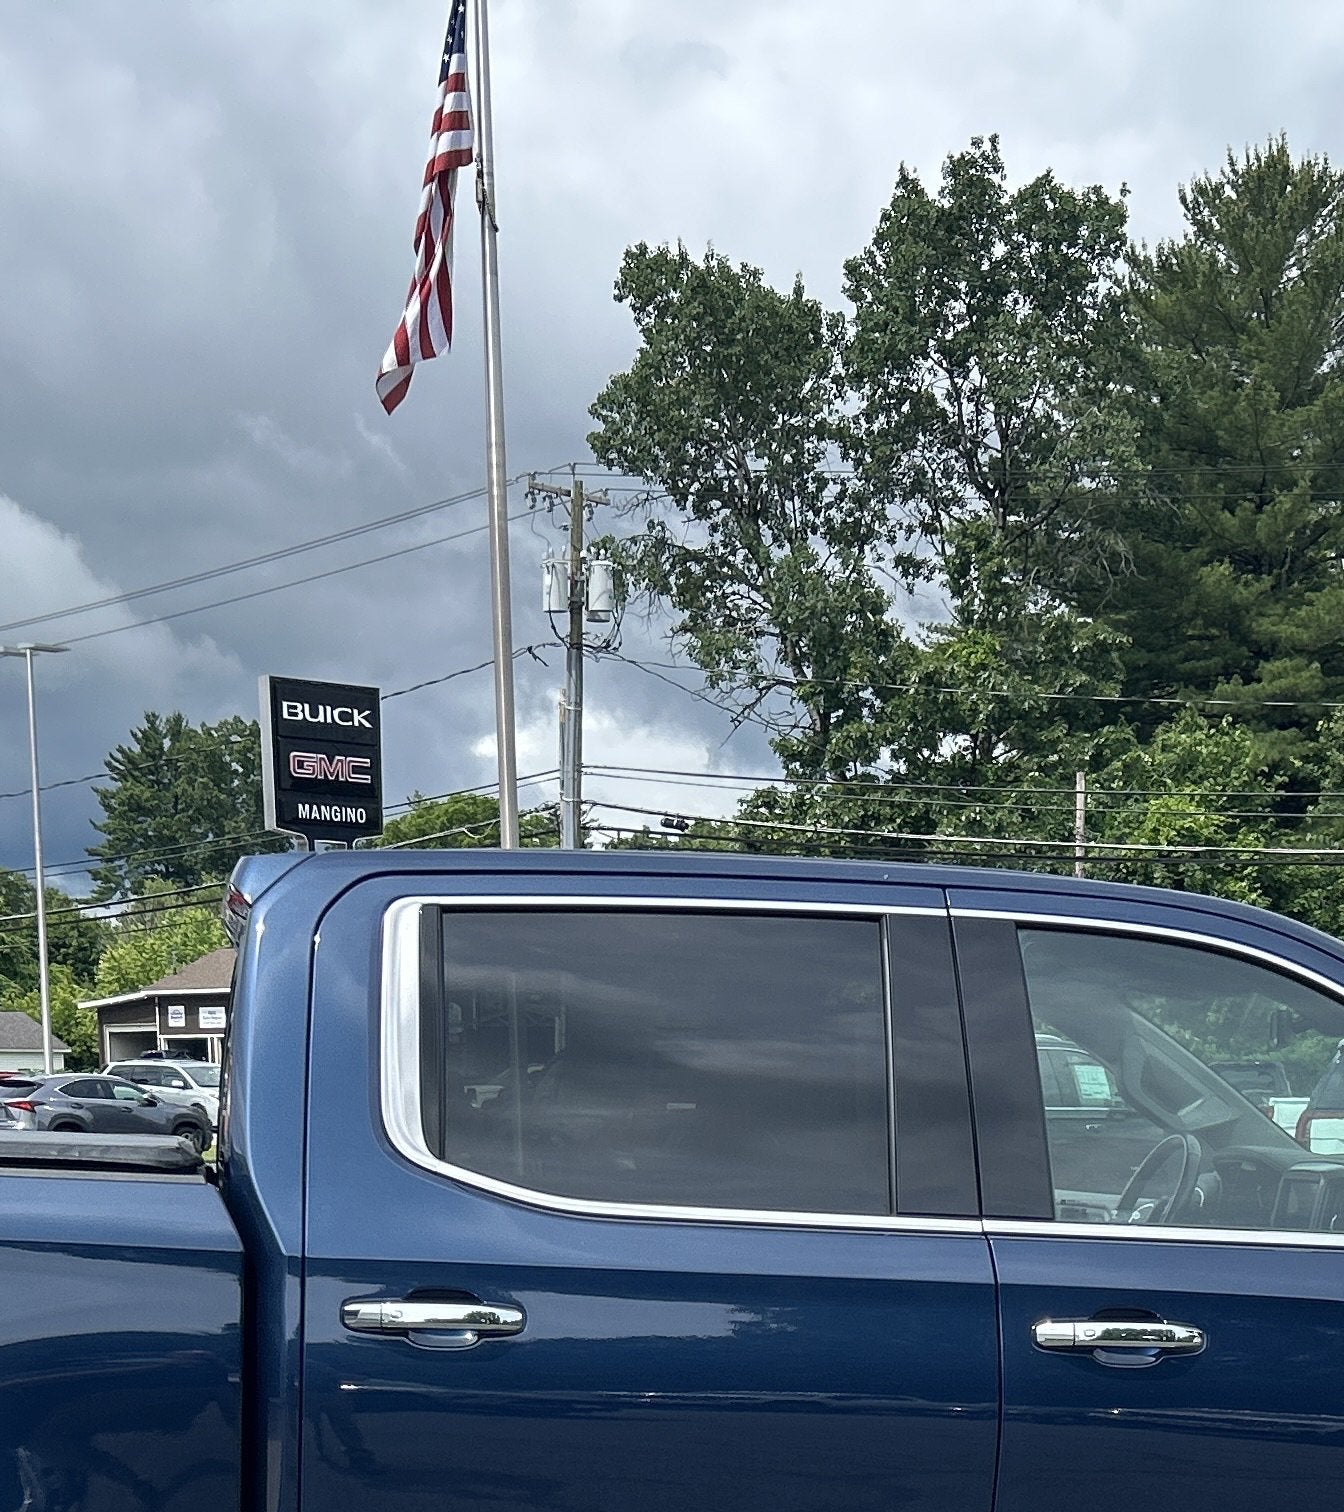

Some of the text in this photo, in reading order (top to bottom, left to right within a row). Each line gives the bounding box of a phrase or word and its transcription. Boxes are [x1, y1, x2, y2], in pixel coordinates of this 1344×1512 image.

[281, 700, 373, 729] BUICK
[289, 751, 372, 784] GMC
[298, 803, 367, 824] MANGINO
